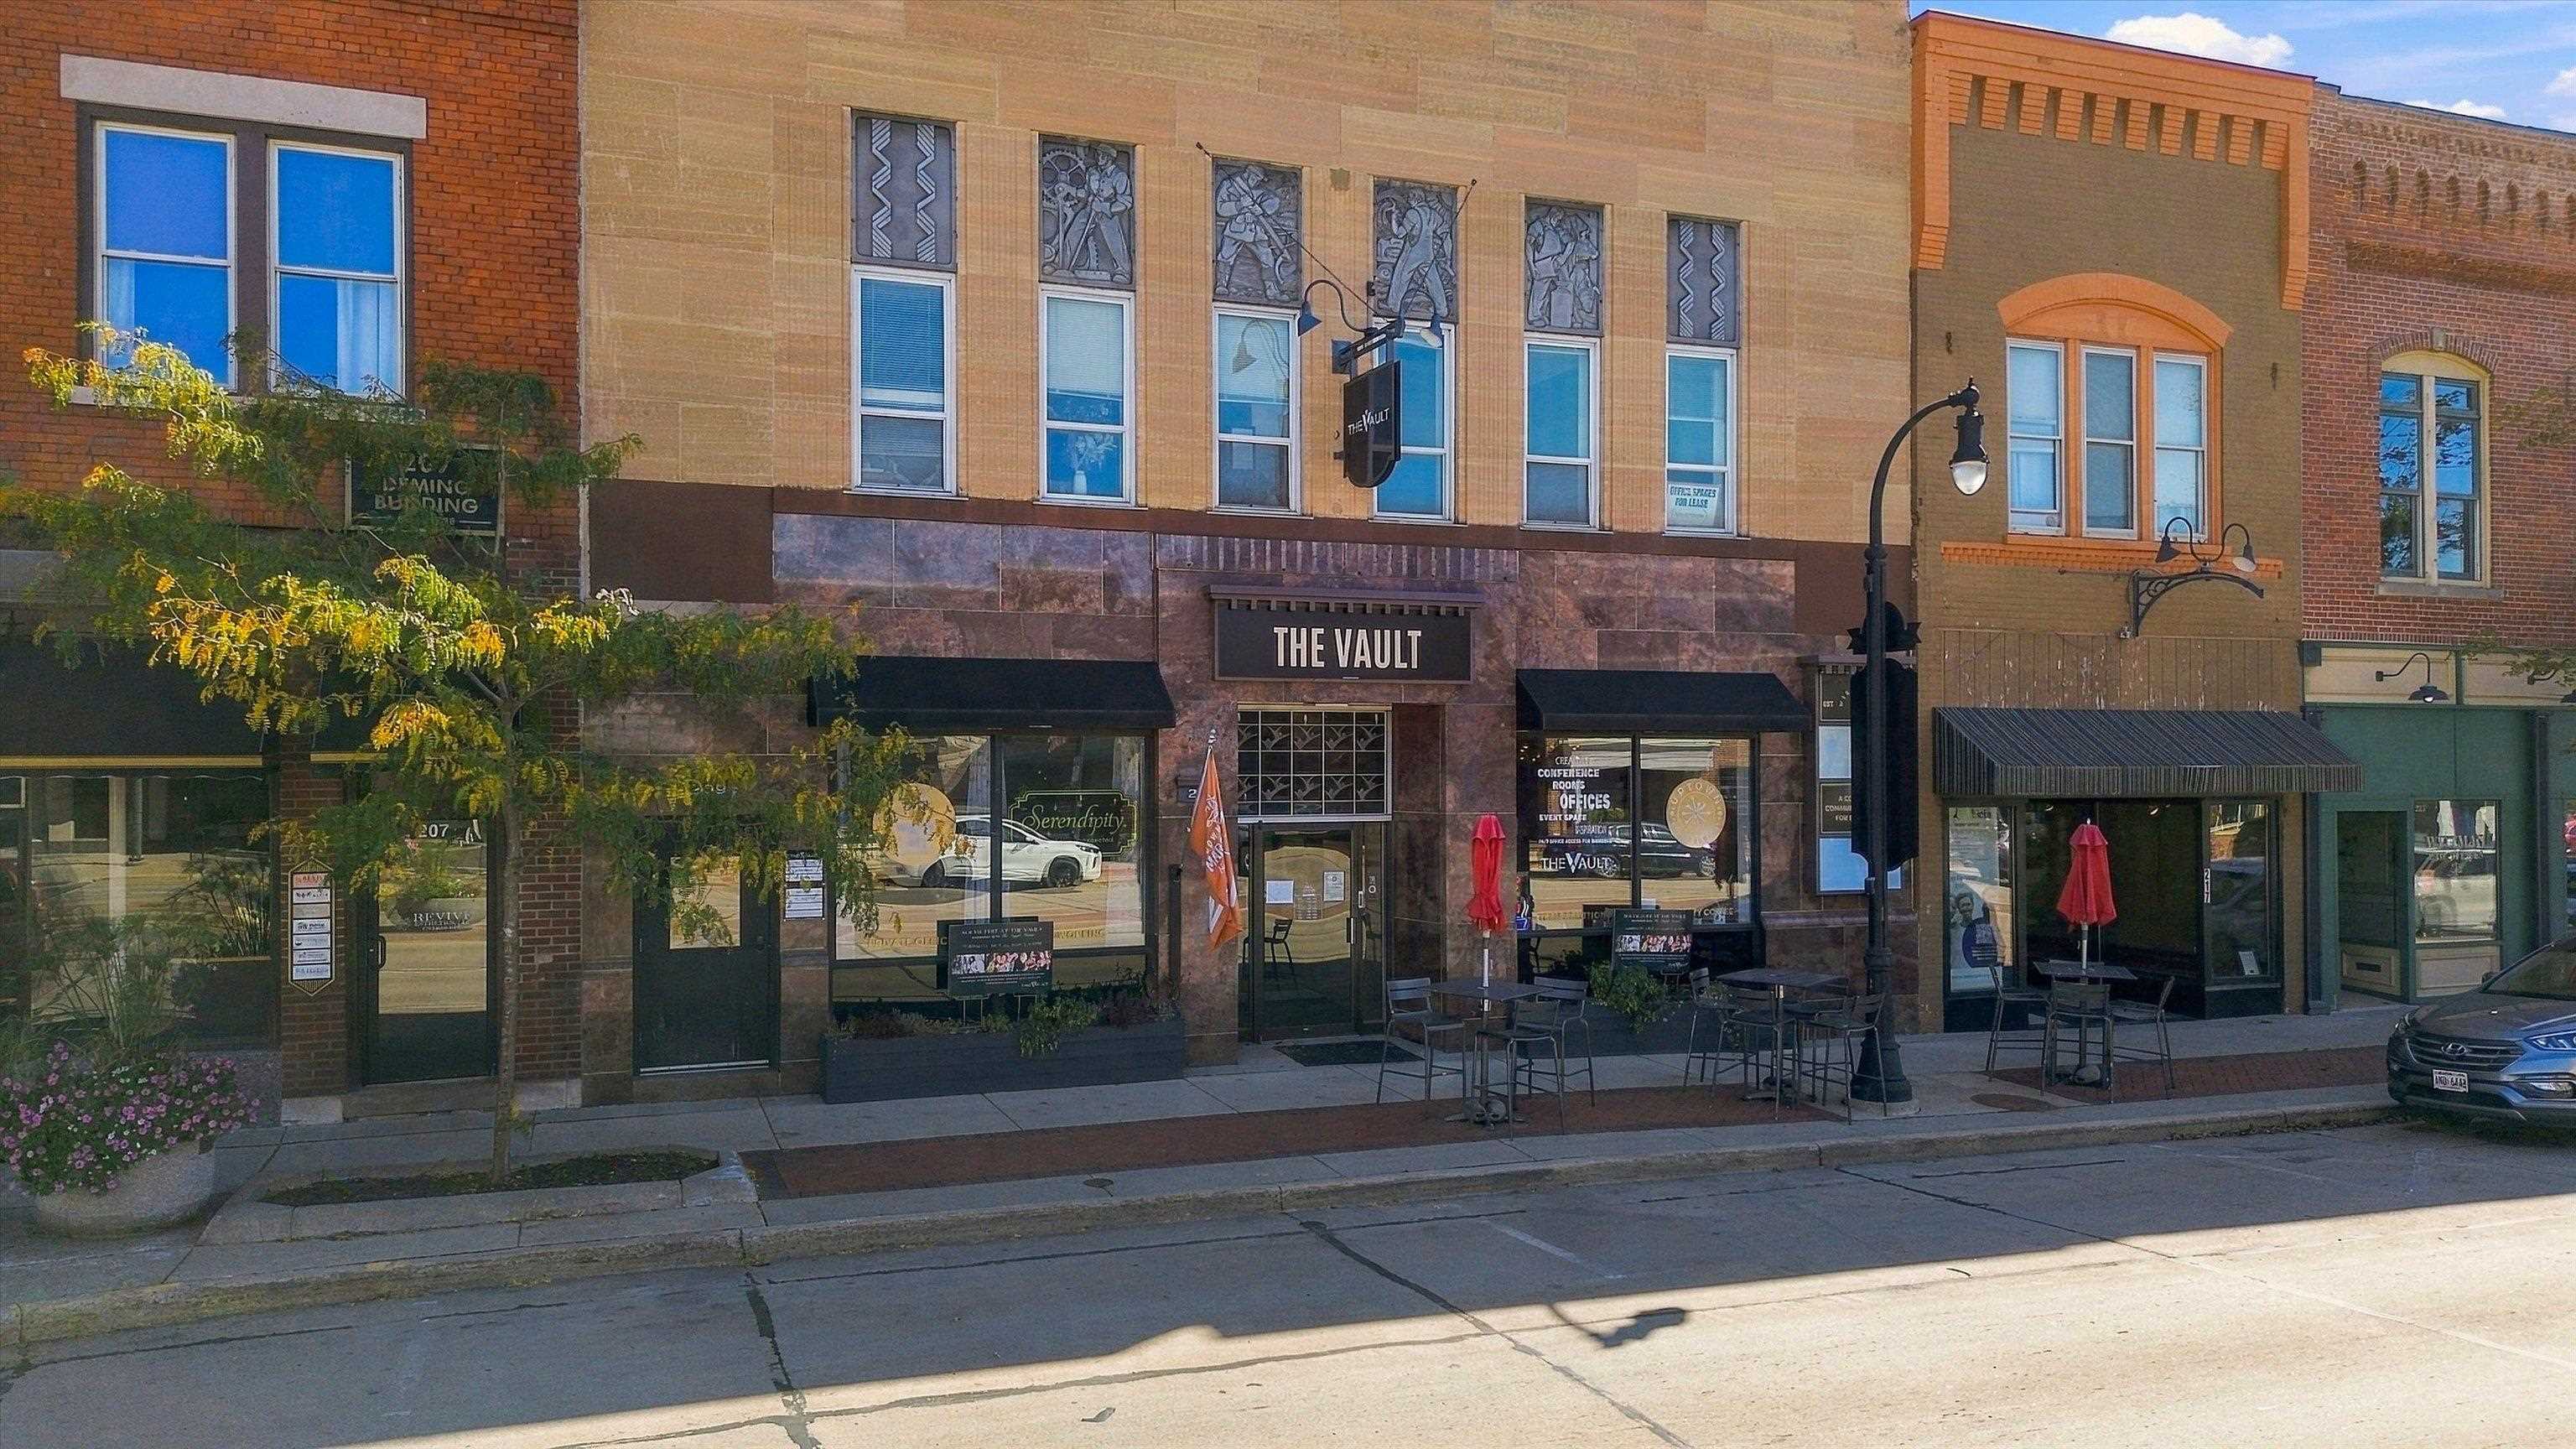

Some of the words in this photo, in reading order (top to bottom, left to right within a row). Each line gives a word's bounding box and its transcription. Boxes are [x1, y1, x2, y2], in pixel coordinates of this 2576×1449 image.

[1670, 486, 1691, 496] OFFICE
[1692, 488, 1716, 498] SPACES
[1675, 497, 1687, 506] FOR
[1689, 498, 1709, 508] LEASE
[1274, 626, 1325, 667] THE
[1334, 628, 1422, 669] VAULT
[1537, 768, 1600, 778] CONFERENCE
[1552, 780, 1586, 790] ROOMS
[1560, 793, 1611, 810] OFFICES
[1022, 804, 1124, 835] Serendipity
[1539, 813, 1561, 822] EVENT
[1563, 813, 1587, 823] SPACE
[1541, 857, 1566, 870] THE
[1565, 852, 1611, 874] VAULT
